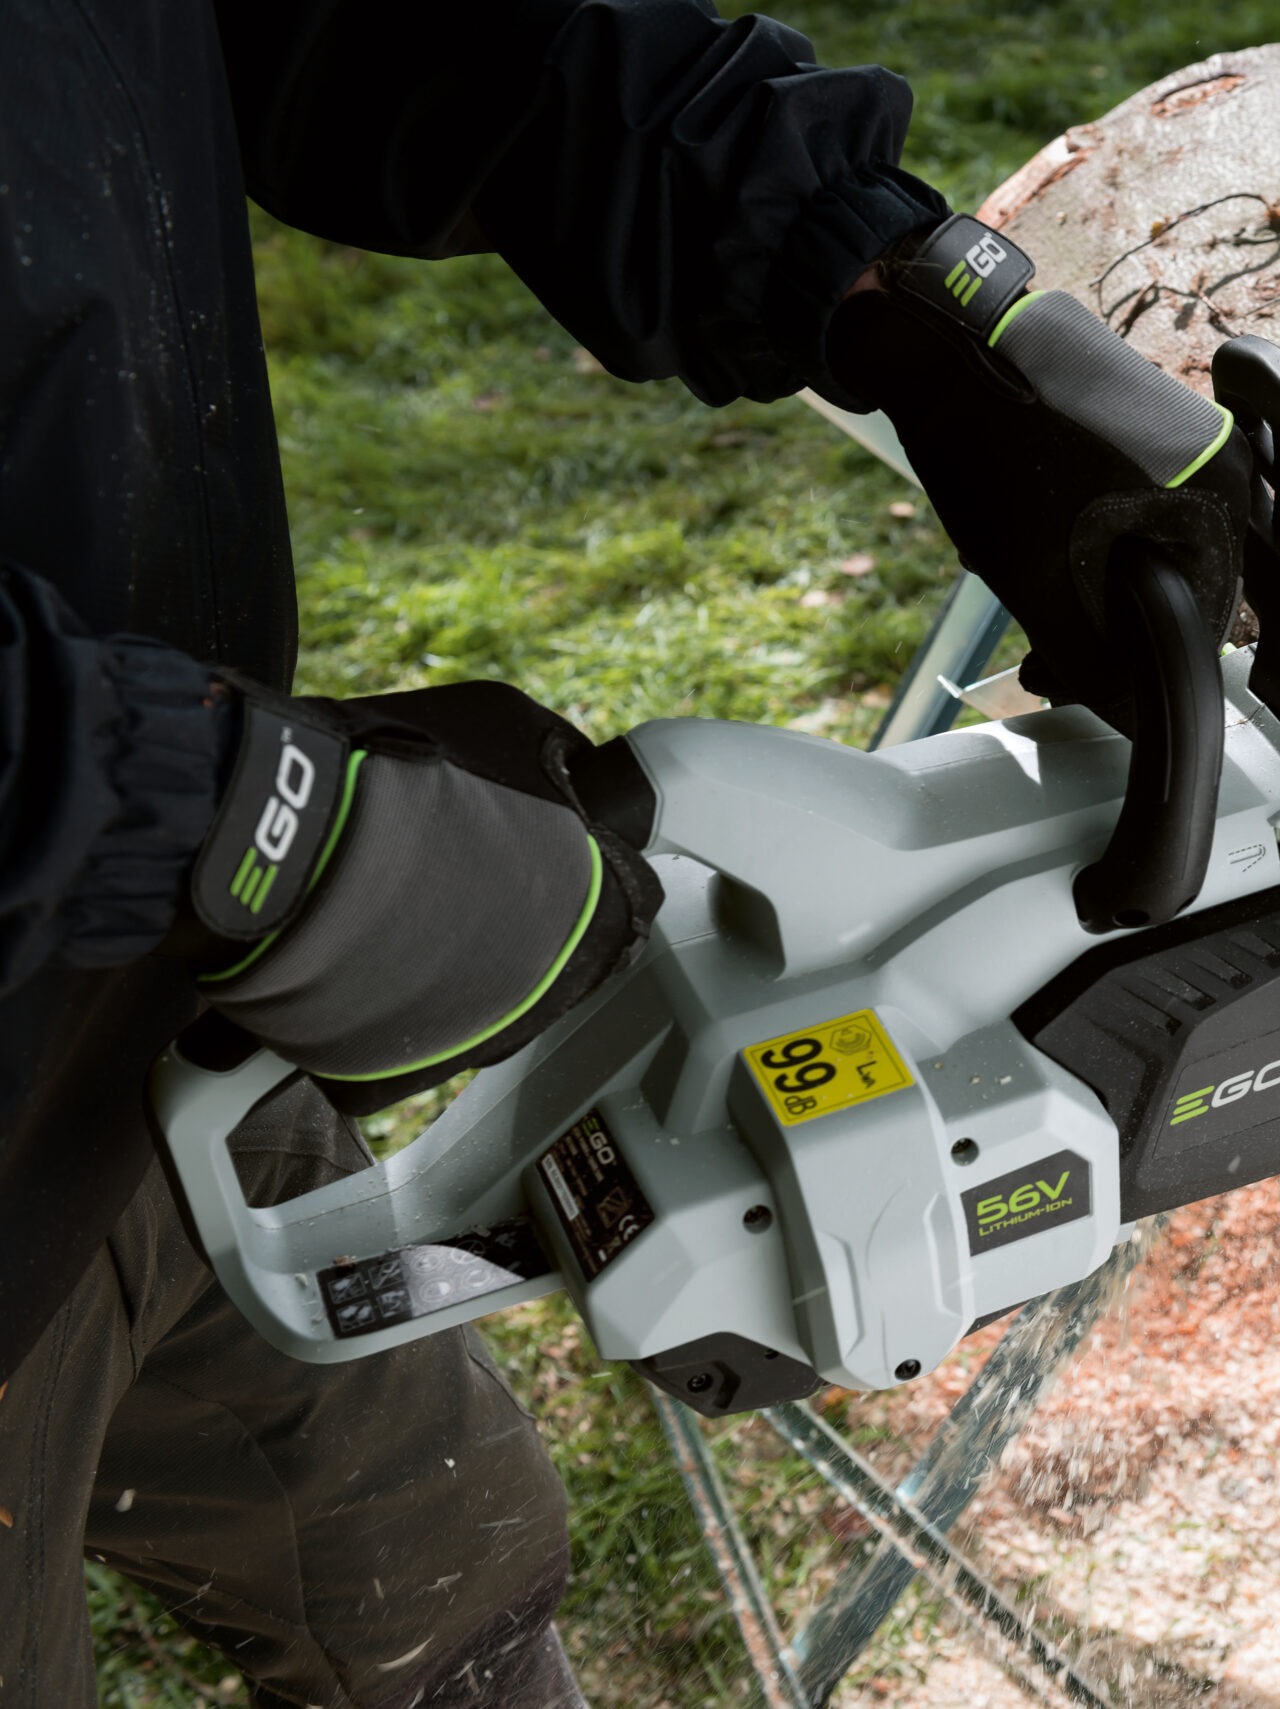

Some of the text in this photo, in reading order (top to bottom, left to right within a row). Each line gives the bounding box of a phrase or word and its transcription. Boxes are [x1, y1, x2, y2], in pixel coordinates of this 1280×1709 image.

[944, 237, 1007, 307] EGO
[230, 744, 315, 914] EGO
[761, 1038, 837, 1116] 99 dB
[582, 1117, 616, 1165] EGO
[977, 1170, 1071, 1226] 56V
[978, 1197, 1073, 1237] LITHIUM-ION
